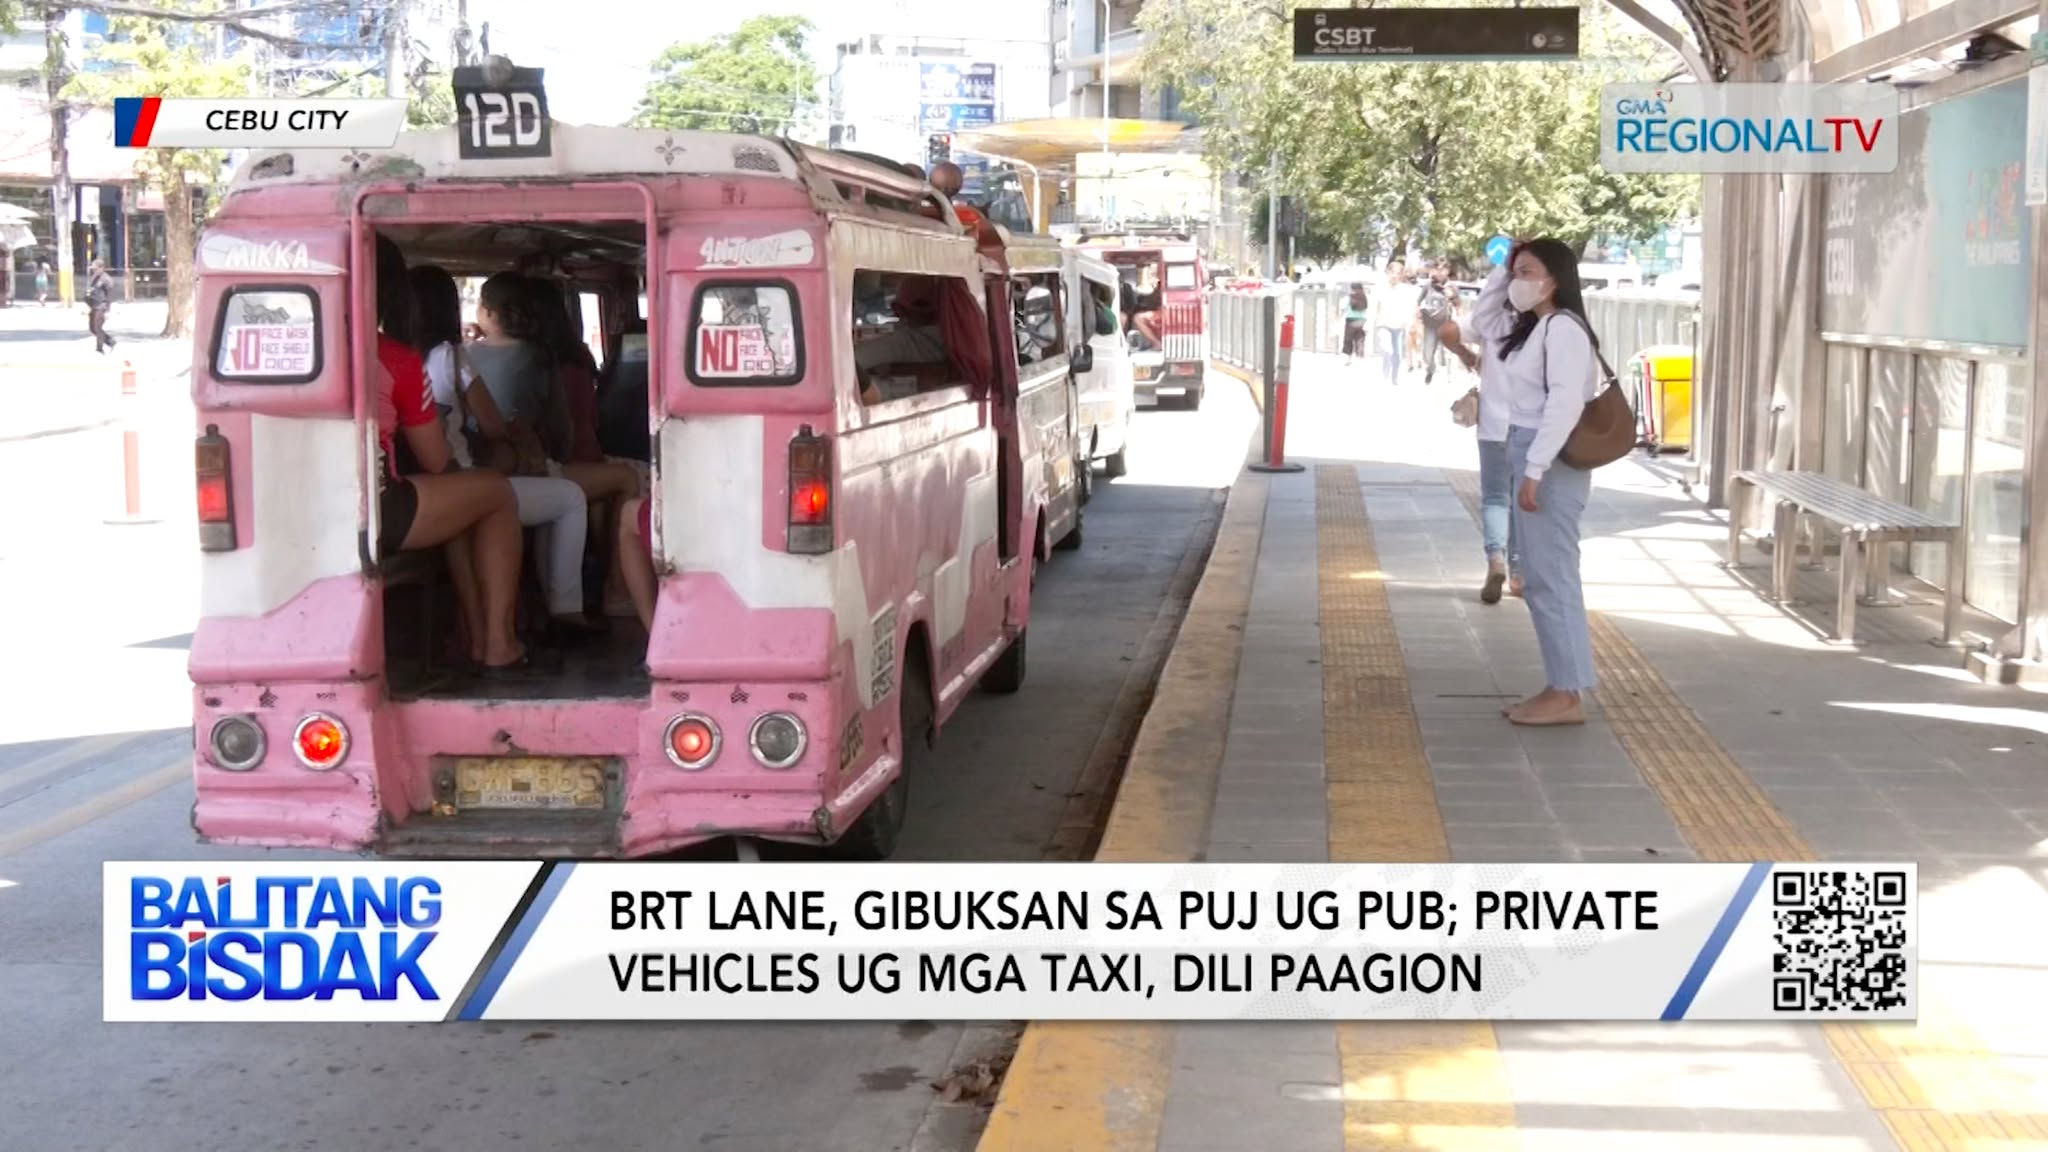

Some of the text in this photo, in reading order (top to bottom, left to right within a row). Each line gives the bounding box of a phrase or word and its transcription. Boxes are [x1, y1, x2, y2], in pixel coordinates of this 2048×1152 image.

[1314, 27, 1377, 45] CSBT
[465, 92, 541, 147] 12D
[225, 239, 310, 269] MIKKA
[702, 328, 738, 371] NO
